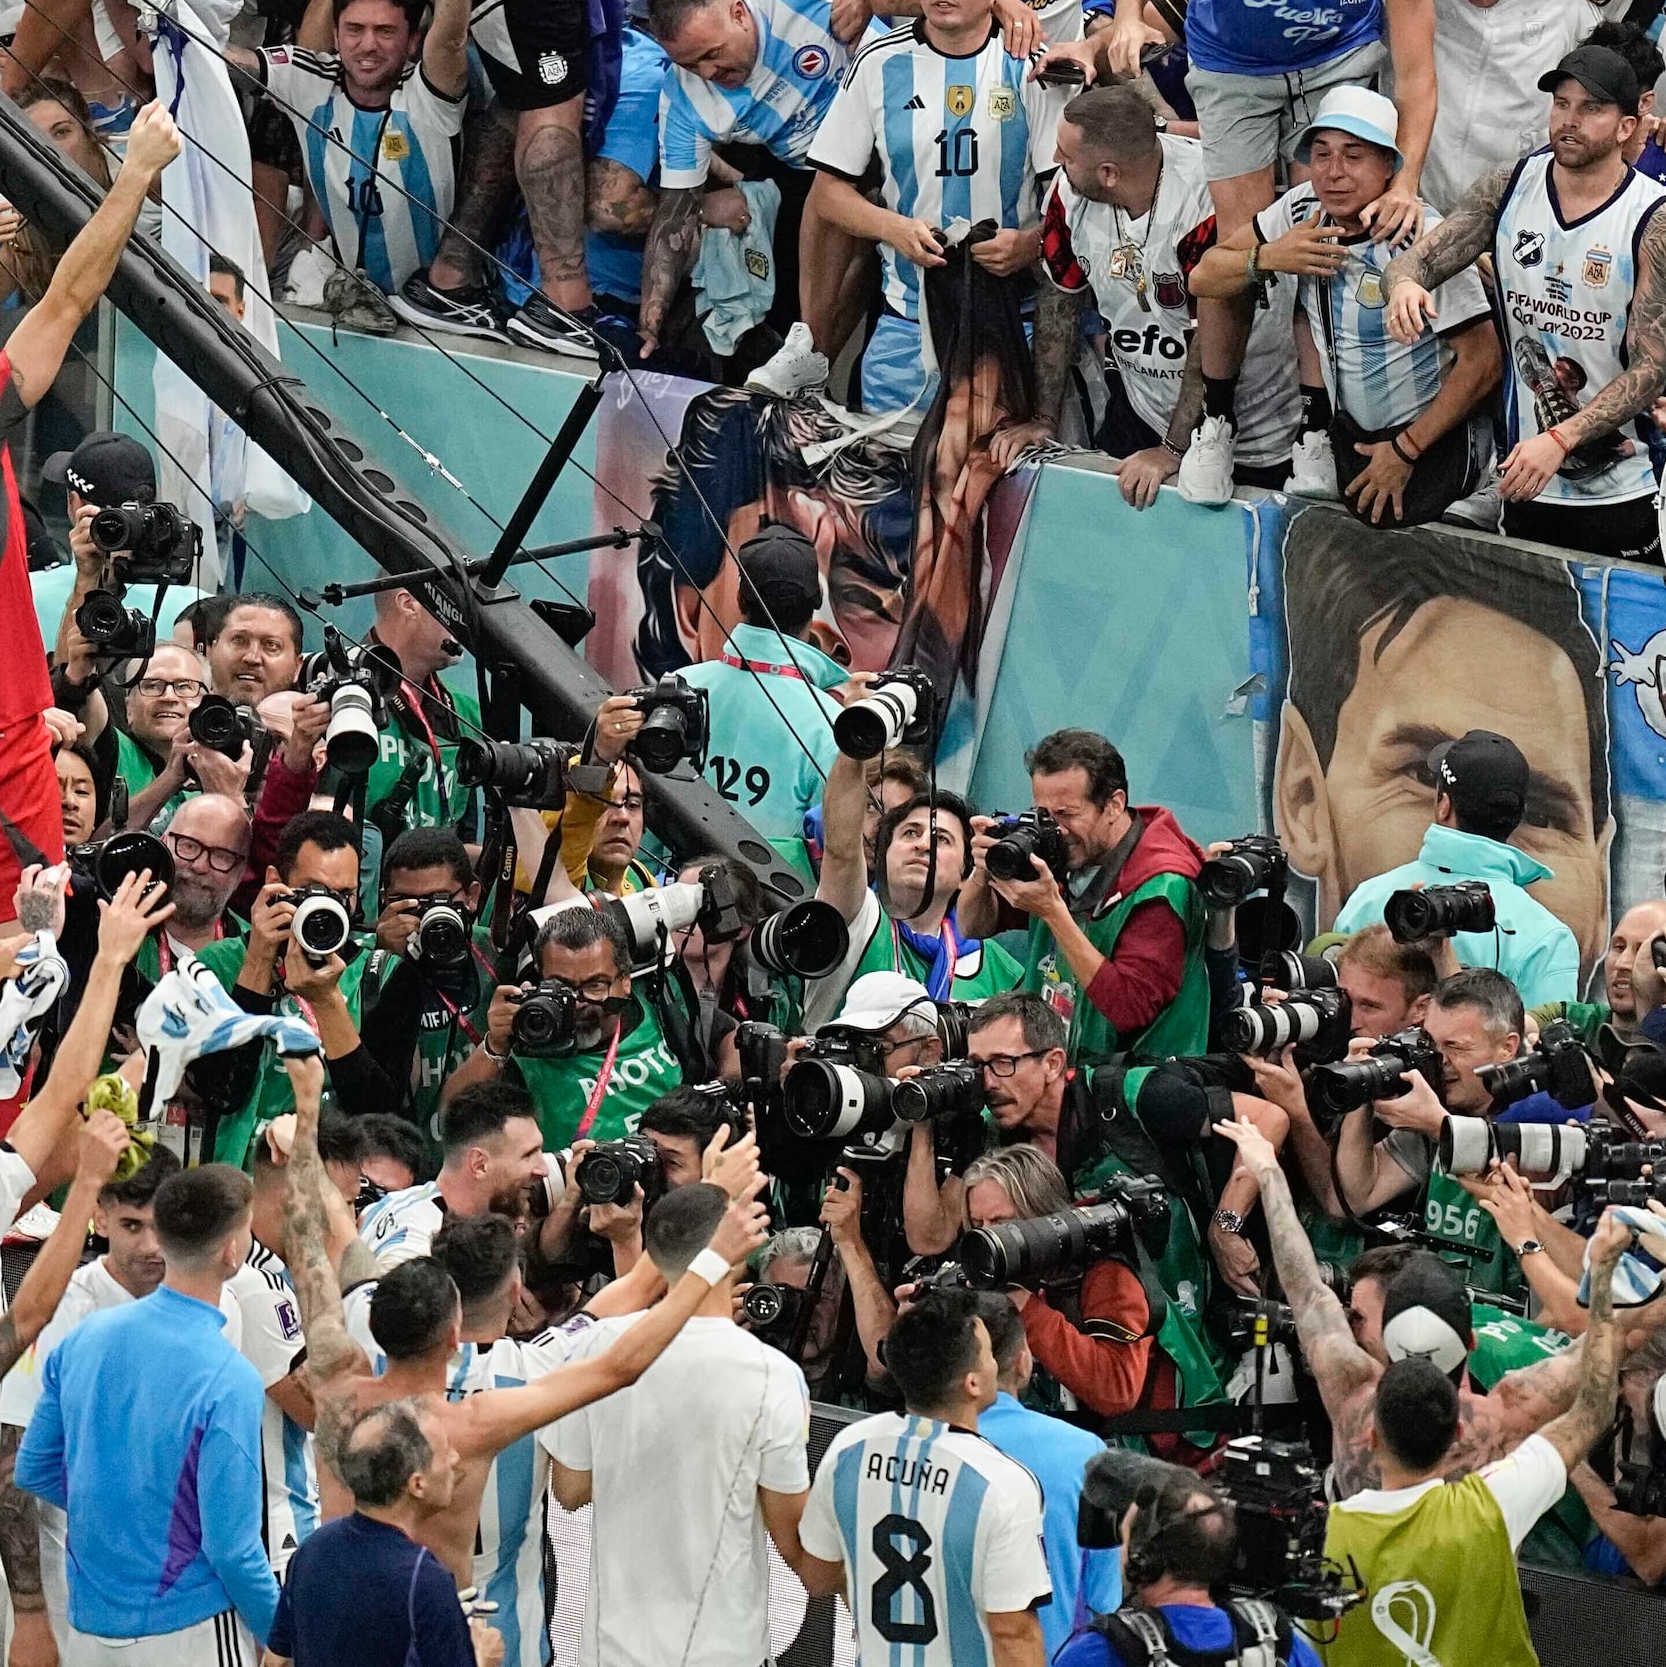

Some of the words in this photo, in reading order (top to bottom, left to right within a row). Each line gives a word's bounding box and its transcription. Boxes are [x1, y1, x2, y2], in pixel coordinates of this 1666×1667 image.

[933, 129, 976, 177] 10
[1532, 296, 1581, 323] WORLD
[1582, 311, 1612, 325] CUP
[501, 844, 515, 881] Canon
[867, 1451, 950, 1499] ACUÑA
[870, 1513, 939, 1645] 8
